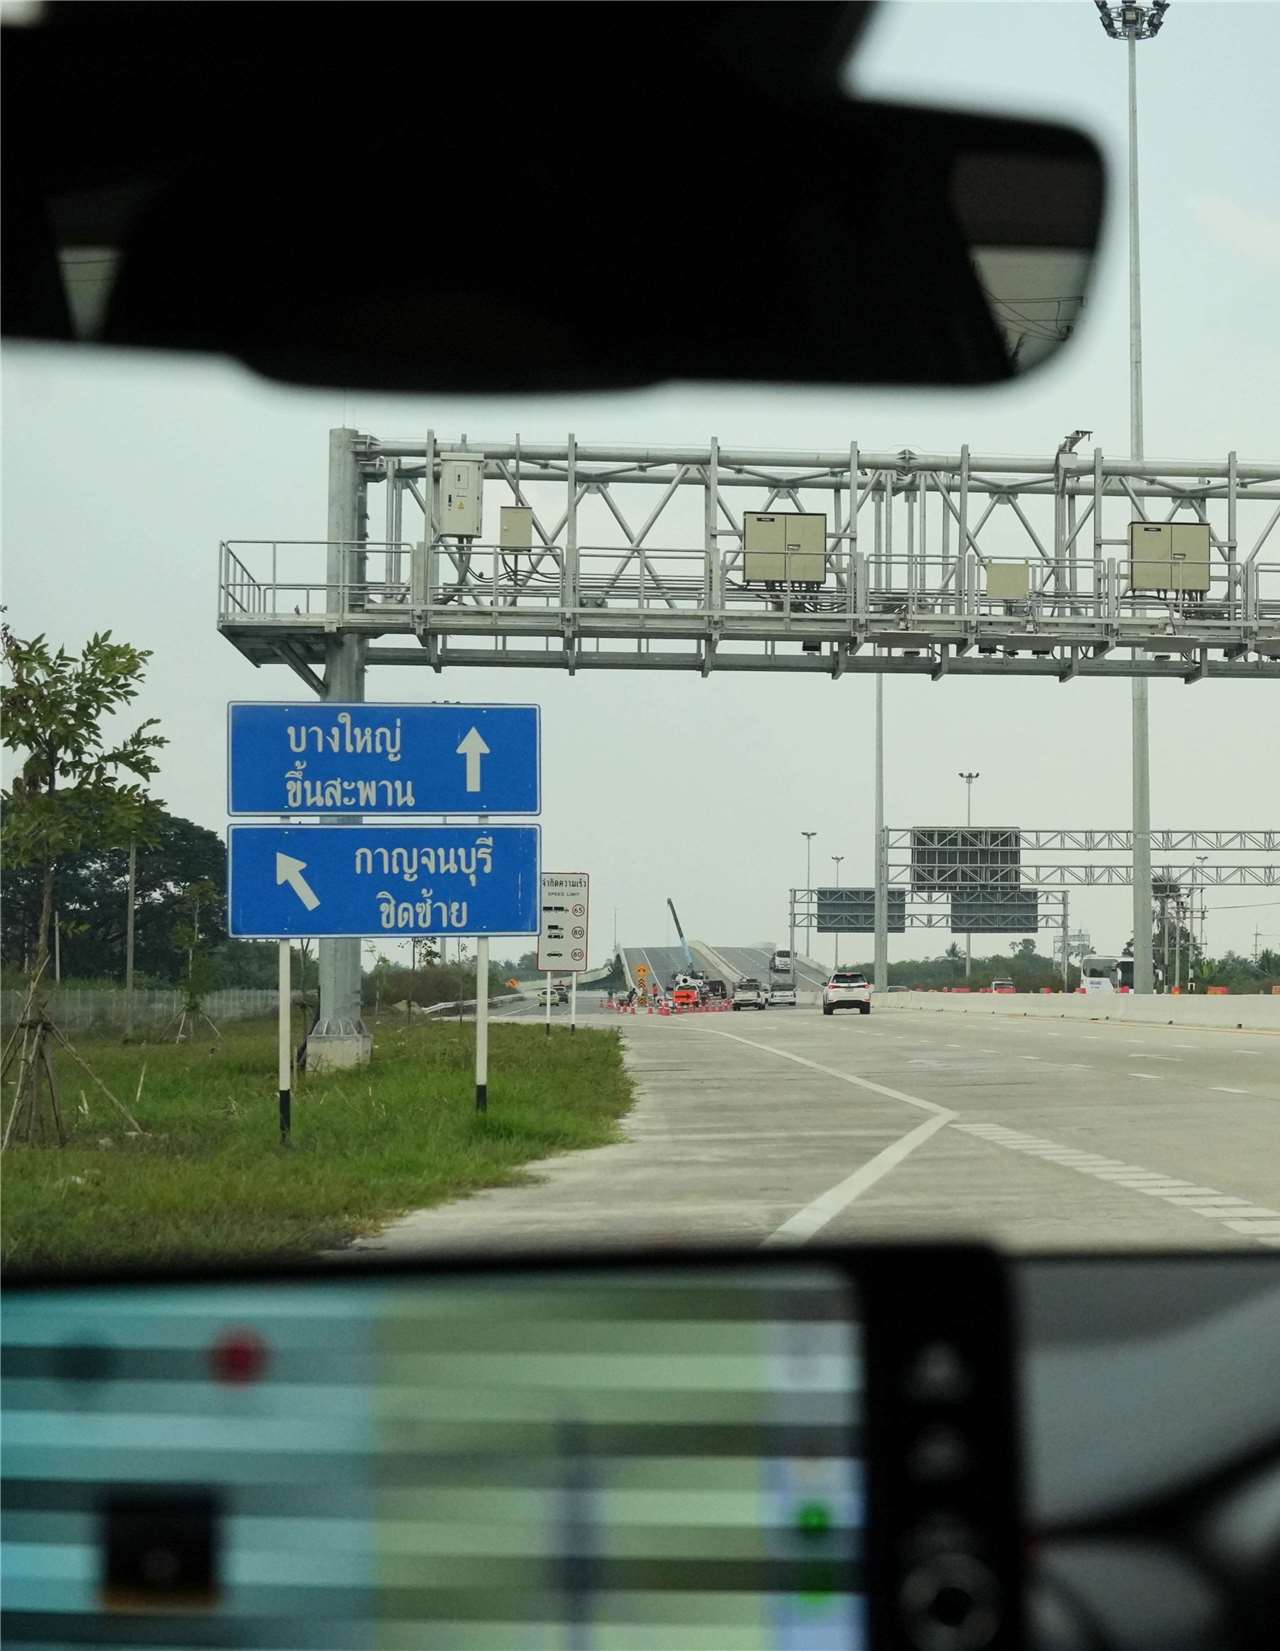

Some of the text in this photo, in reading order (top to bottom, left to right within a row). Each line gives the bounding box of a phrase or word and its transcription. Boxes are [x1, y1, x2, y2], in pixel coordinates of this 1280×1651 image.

[286, 711, 402, 762] บางใหญ่
[284, 759, 416, 808] ขึ้นสะพาน
[354, 836, 494, 887] กาญจนบุรี
[375, 888, 468, 929] ชิดซ้าย
